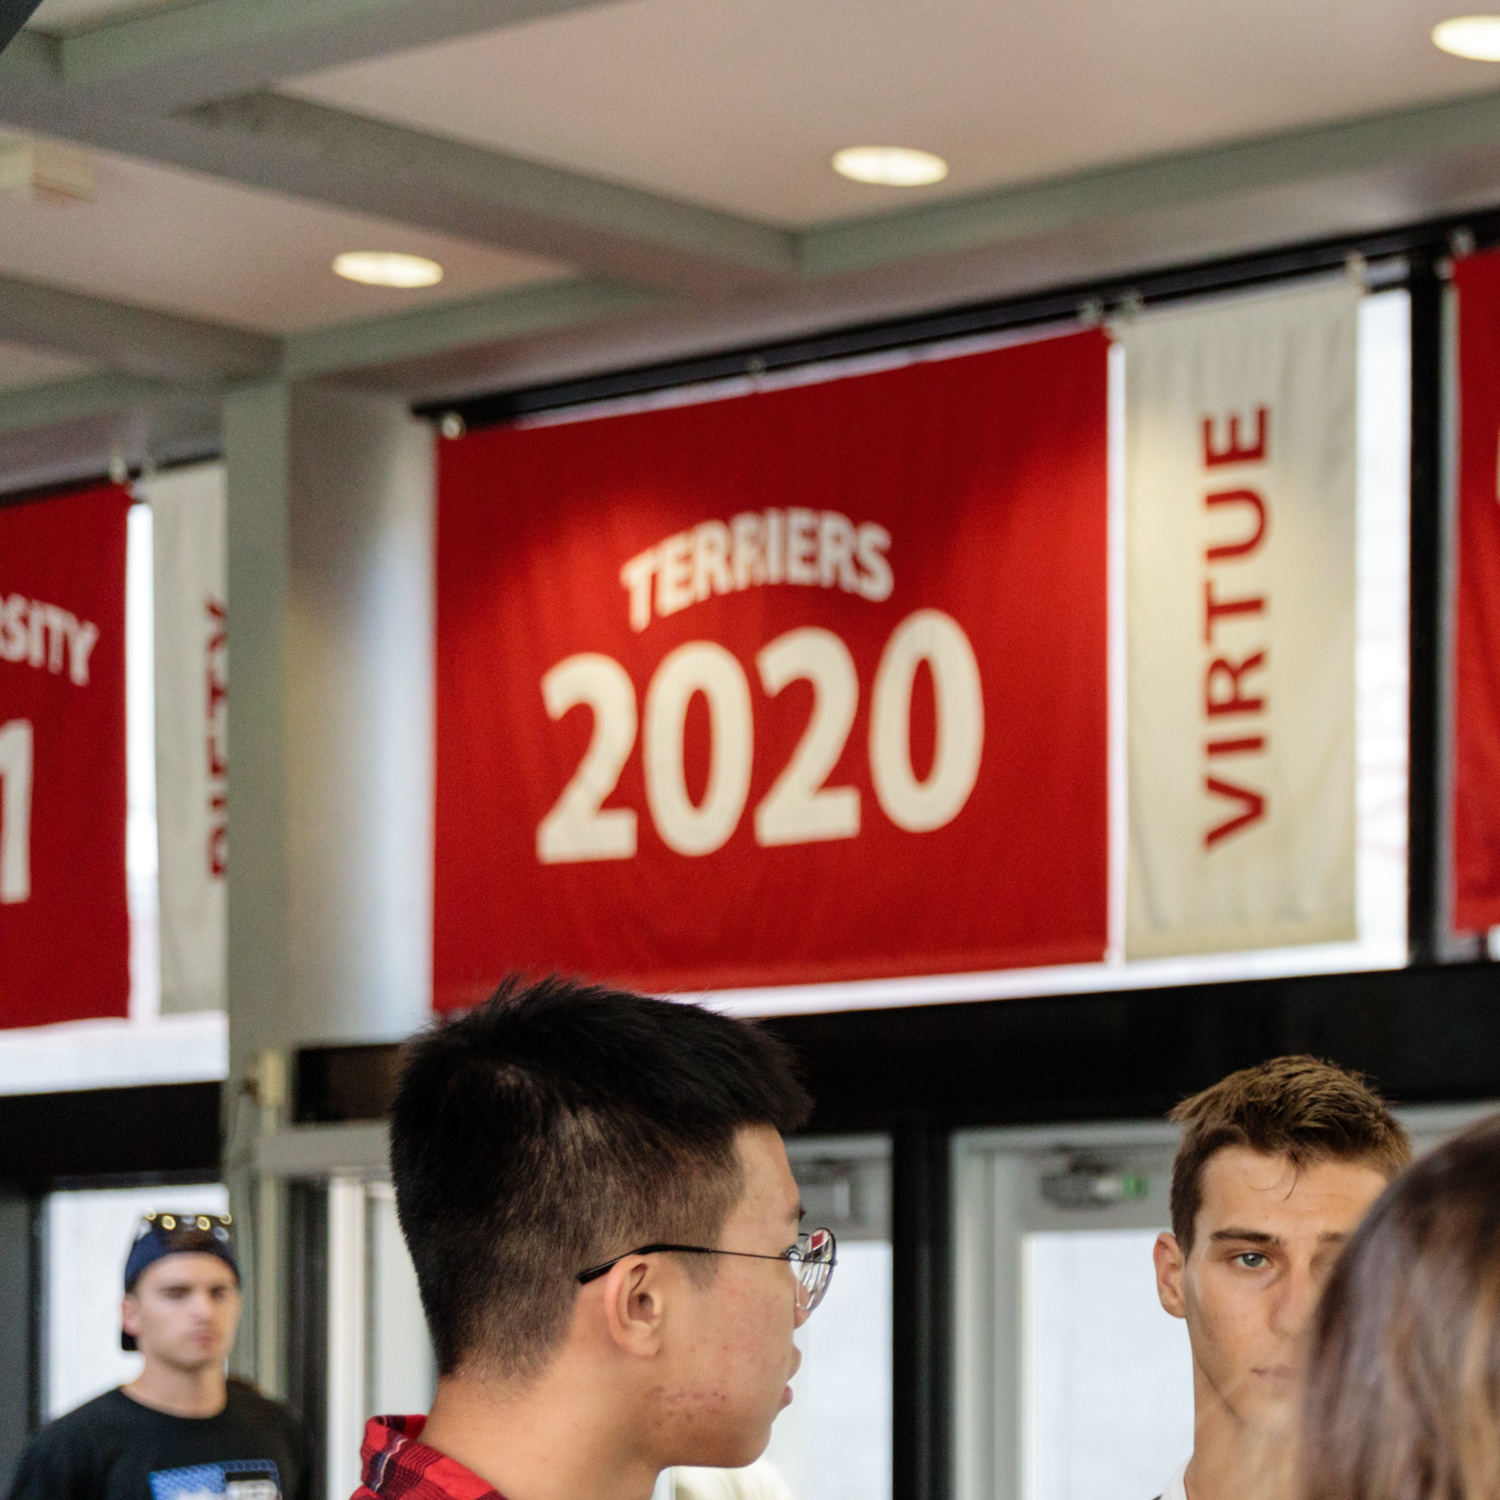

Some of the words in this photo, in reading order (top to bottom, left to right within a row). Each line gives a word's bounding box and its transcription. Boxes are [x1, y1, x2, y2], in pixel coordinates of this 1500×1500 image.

[620, 507, 894, 632] TERRIERS
[1204, 405, 1268, 851] VIRTUE
[536, 608, 984, 865] 2020
